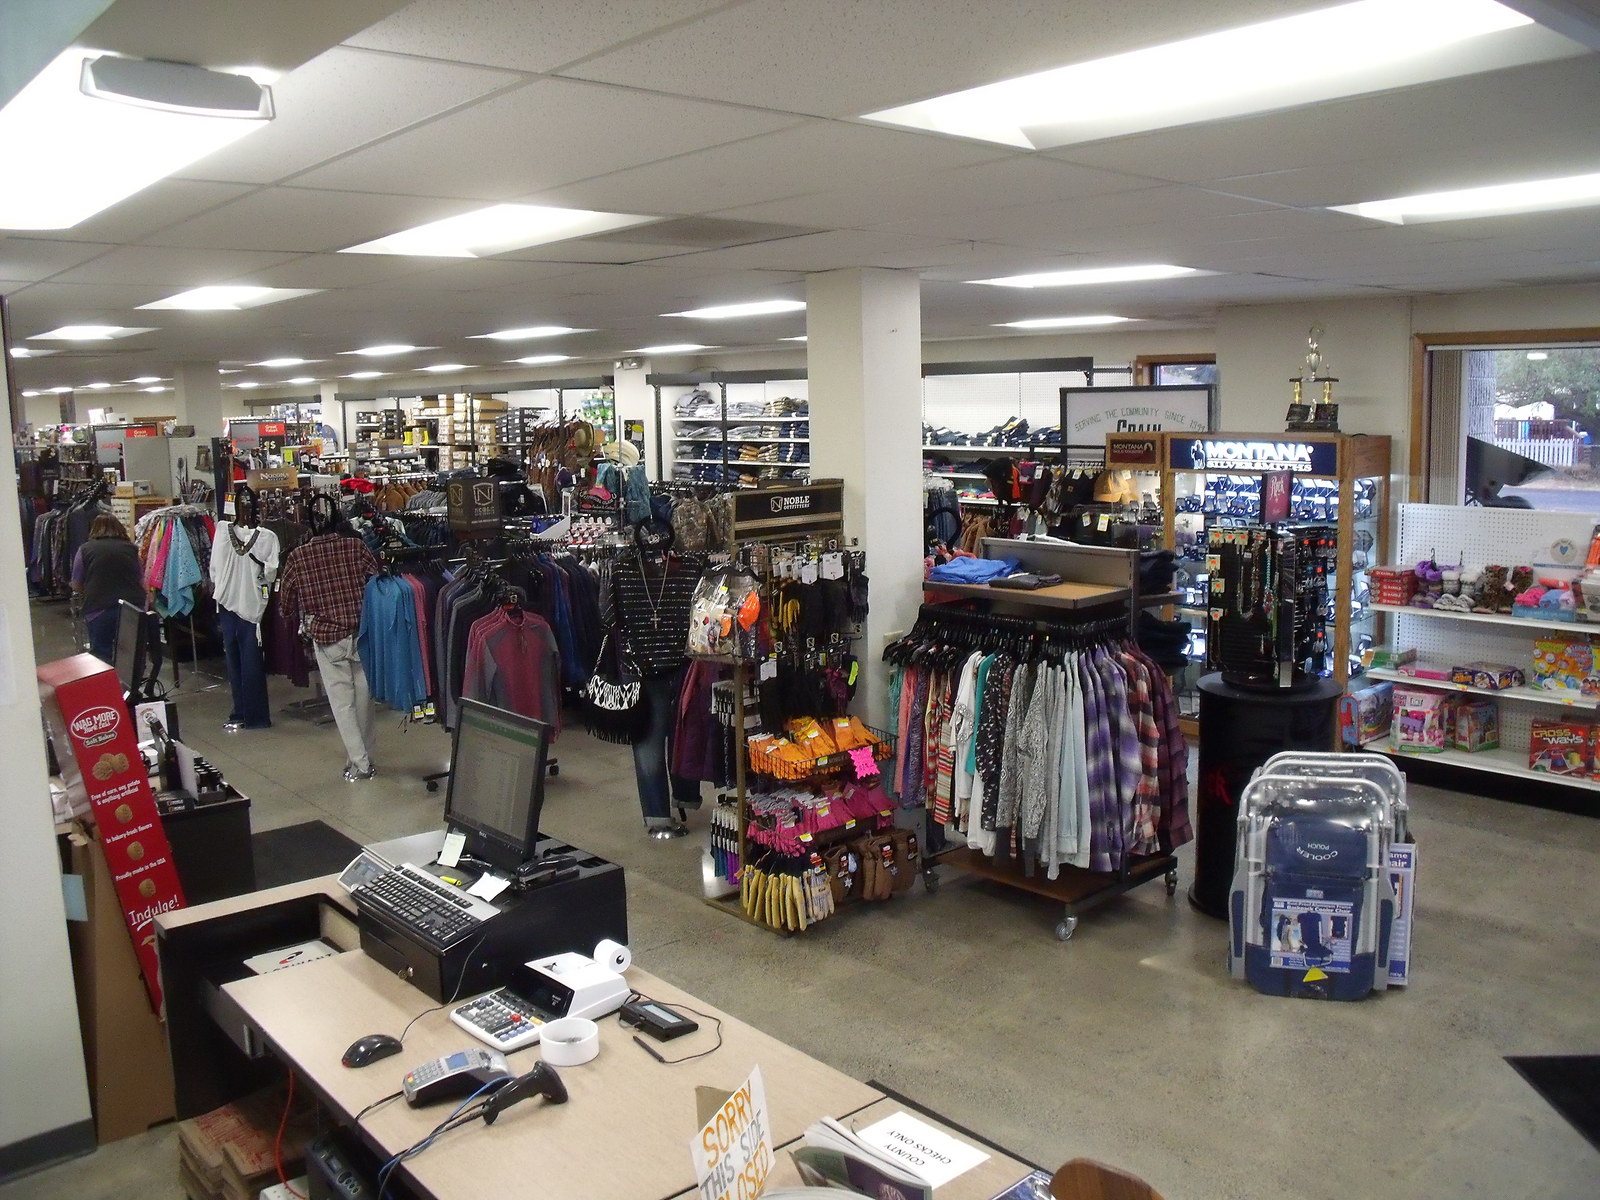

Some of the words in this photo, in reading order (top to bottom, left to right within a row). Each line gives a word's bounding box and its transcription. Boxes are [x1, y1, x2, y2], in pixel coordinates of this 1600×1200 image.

[1075, 414, 1101, 432] SERVING
[1105, 409, 1118, 419] THE
[1121, 408, 1160, 417] COMMUNITY
[1165, 411, 1185, 424] SINCE
[1205, 441, 1312, 461] MONTANA
[1206, 461, 1312, 472] SILVERSMITHS
[784, 496, 810, 505] NOBLE
[73, 717, 92, 731] WAG
[93, 710, 116, 724] MORE
[1533, 729, 1571, 738] CROSS
[1297, 846, 1338, 860] COOLER
[129, 894, 180, 926] Indulge!
[703, 1080, 753, 1168] SORRY
[887, 1130, 914, 1144] ONLY
[700, 1153, 734, 1200] THIS
[740, 1109, 764, 1162] SIDE
[884, 1144, 925, 1166] COUNTY
[915, 1143, 951, 1164] CHECKS
[718, 1141, 768, 1200] OSED
